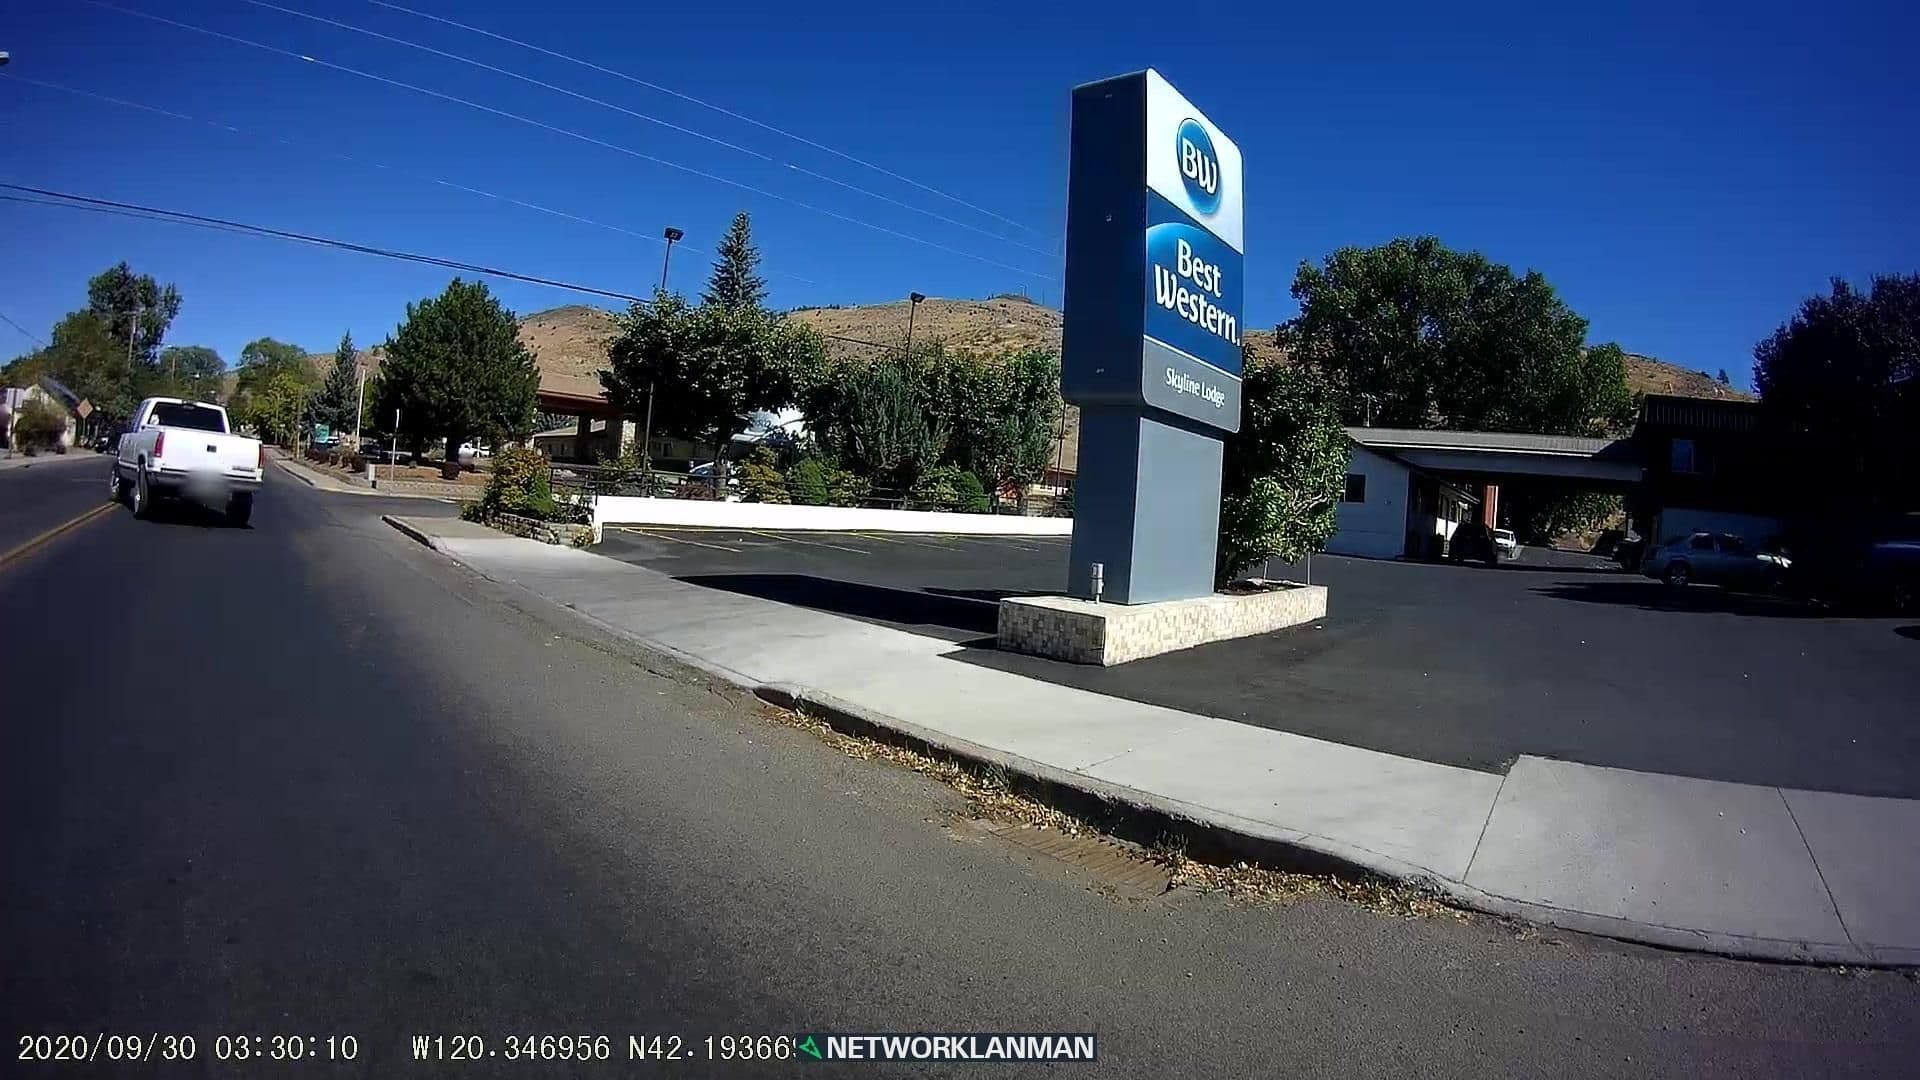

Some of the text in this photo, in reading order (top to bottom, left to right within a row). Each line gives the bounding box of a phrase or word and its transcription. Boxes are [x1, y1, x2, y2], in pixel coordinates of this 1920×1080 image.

[1182, 136, 1217, 195] BW
[1178, 238, 1222, 298] Best
[1166, 367, 1224, 408] Skyline Lodge
